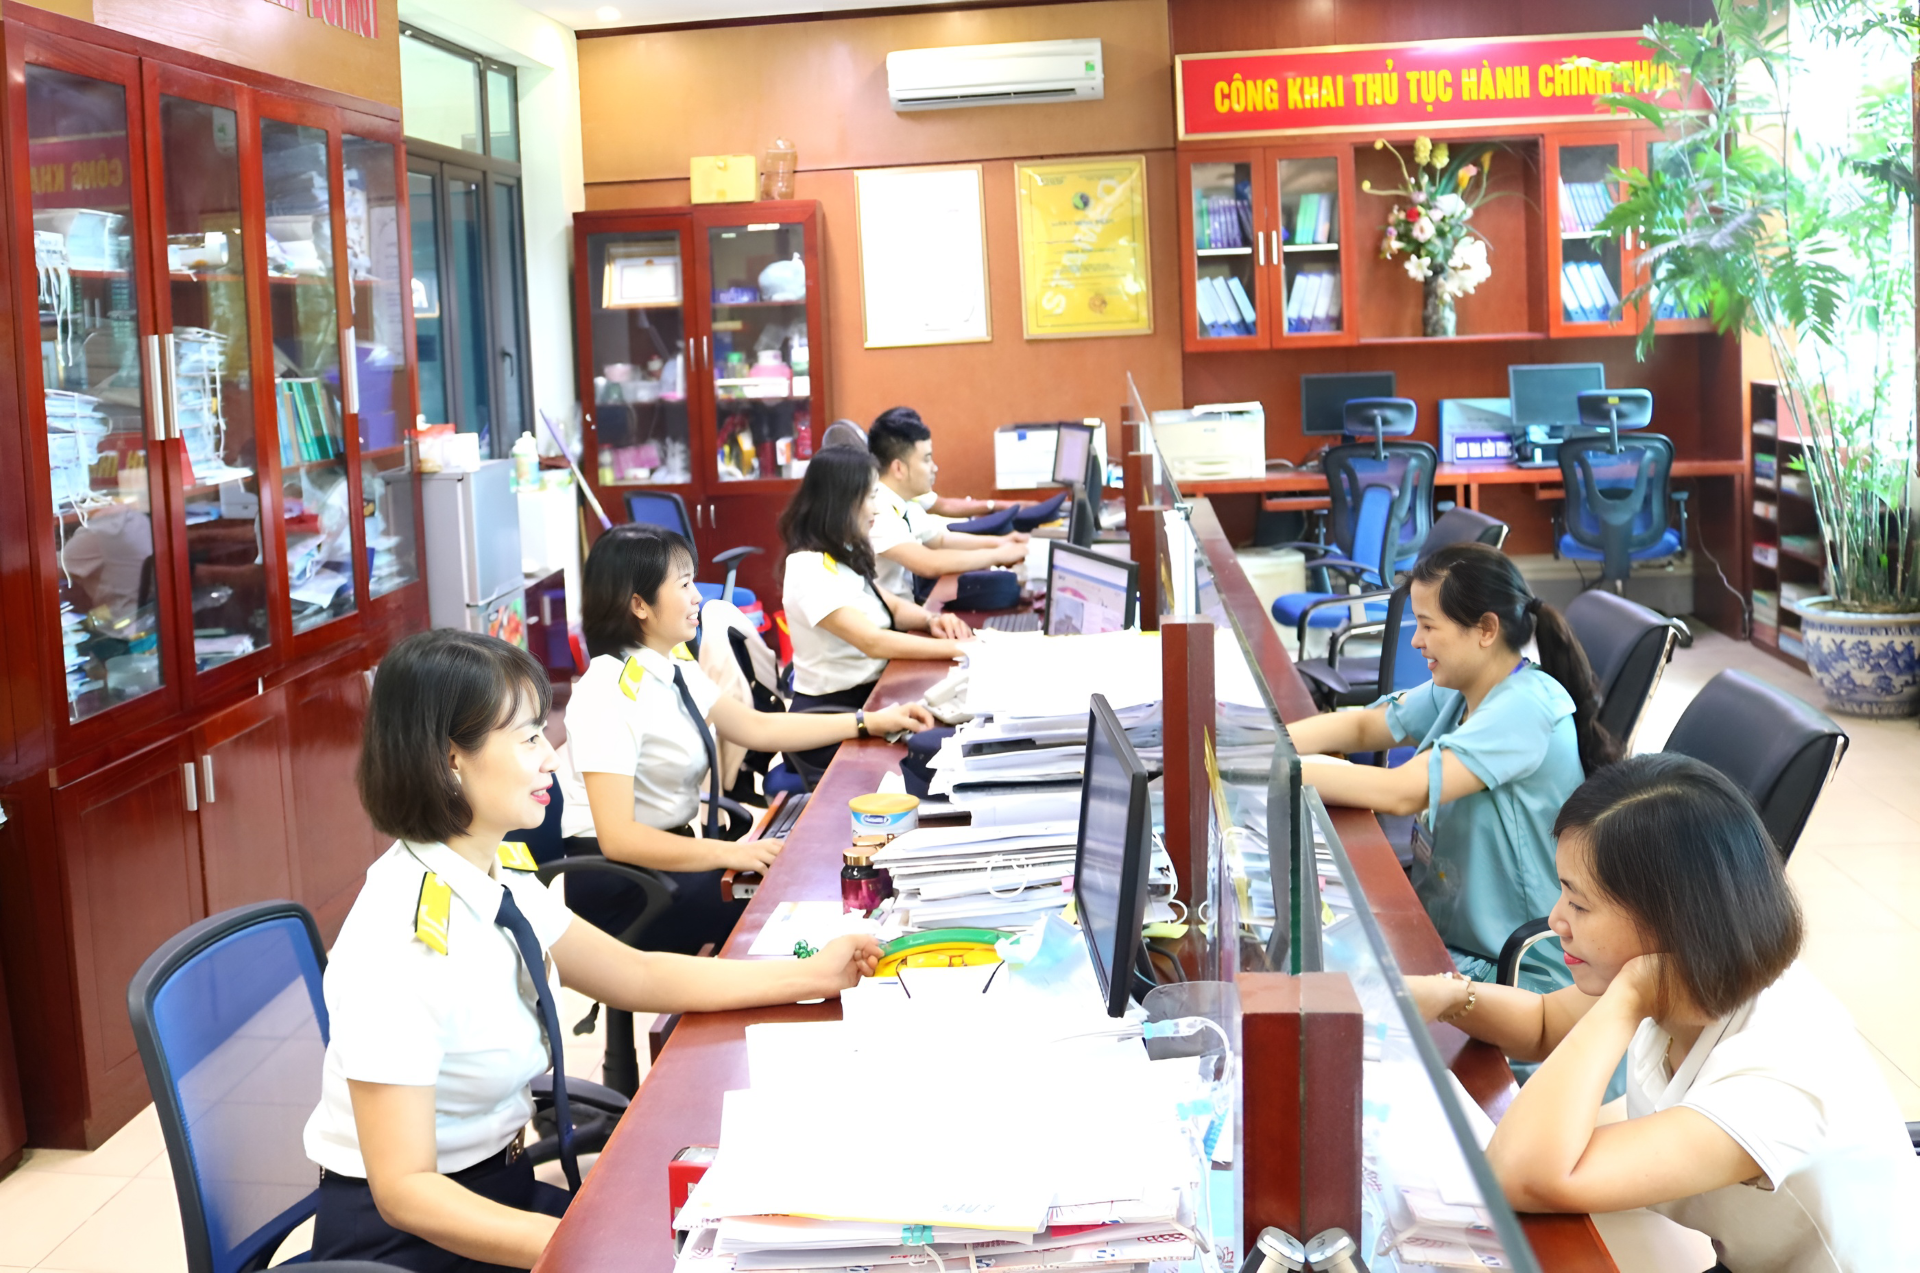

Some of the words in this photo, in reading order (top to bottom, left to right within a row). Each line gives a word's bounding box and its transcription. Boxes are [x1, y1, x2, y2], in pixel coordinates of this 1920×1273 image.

[1214, 73, 1279, 113] CÔNG
[1287, 75, 1344, 110] KHAI
[1352, 58, 1398, 106] THỦ
[1406, 69, 1453, 112] TỤC
[1461, 59, 1530, 101] HÀNH
